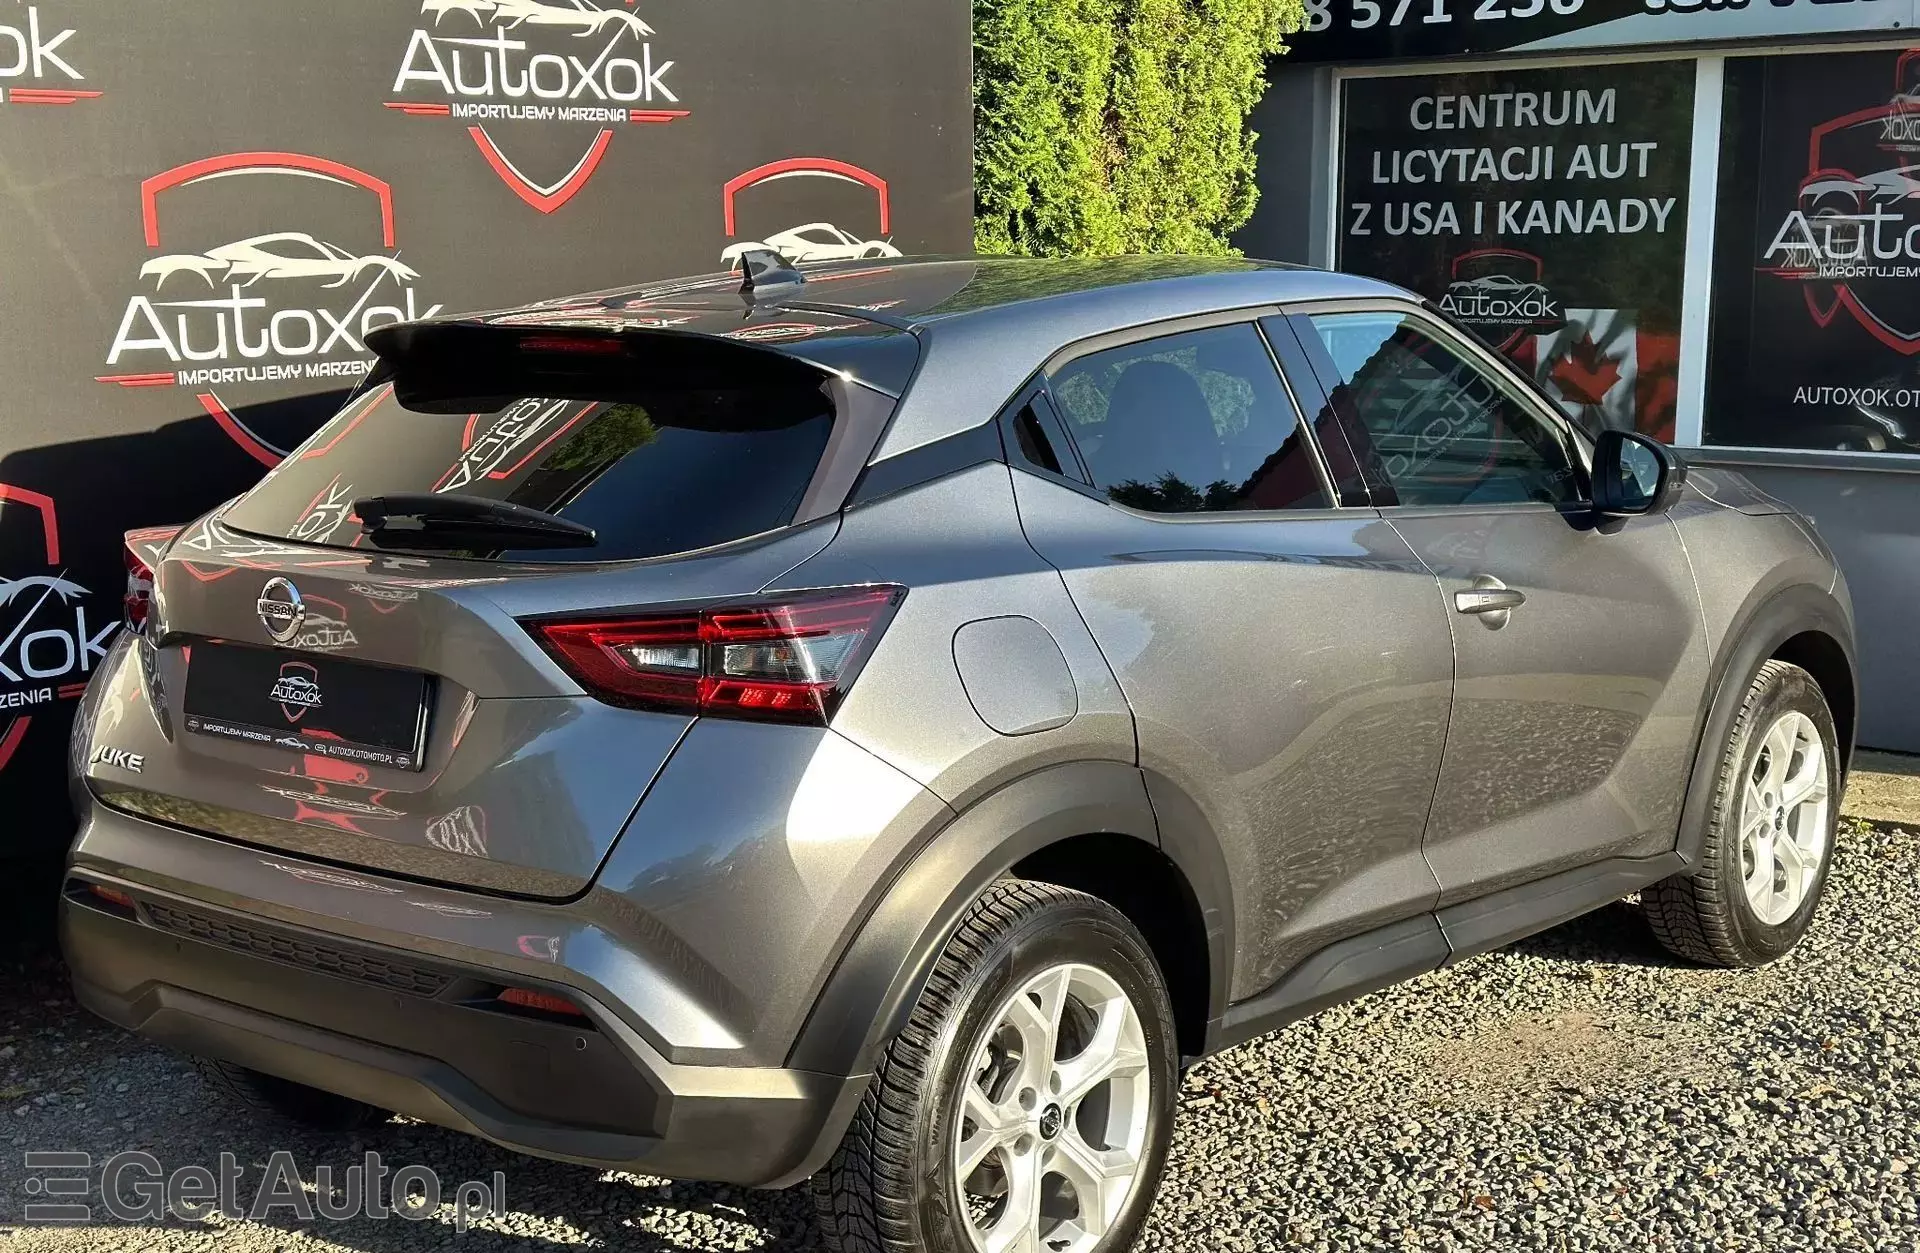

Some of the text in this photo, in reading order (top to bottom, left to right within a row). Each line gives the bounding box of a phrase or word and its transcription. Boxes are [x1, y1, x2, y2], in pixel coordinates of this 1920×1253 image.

[392, 23, 679, 102] Autoxok
[452, 103, 627, 122] IMPORTUJEMY MARZENIA
[1410, 88, 1616, 131] CENTRUM
[1372, 142, 1657, 184] LICYTACJI AUT
[1351, 197, 1676, 236] Z USA I KANADY
[1819, 266, 1920, 277] IMPORTUJEM
[1439, 291, 1558, 317] Autoxok
[178, 364, 302, 386] IMPORTUJEMY
[259, 603, 297, 617] NISSAN
[270, 684, 322, 704] Autoxok
[91, 744, 145, 774] JUKE
[242, 730, 271, 742] MARZENIA
[328, 745, 393, 764] AUTOXOK.OTOMOTO.PL
